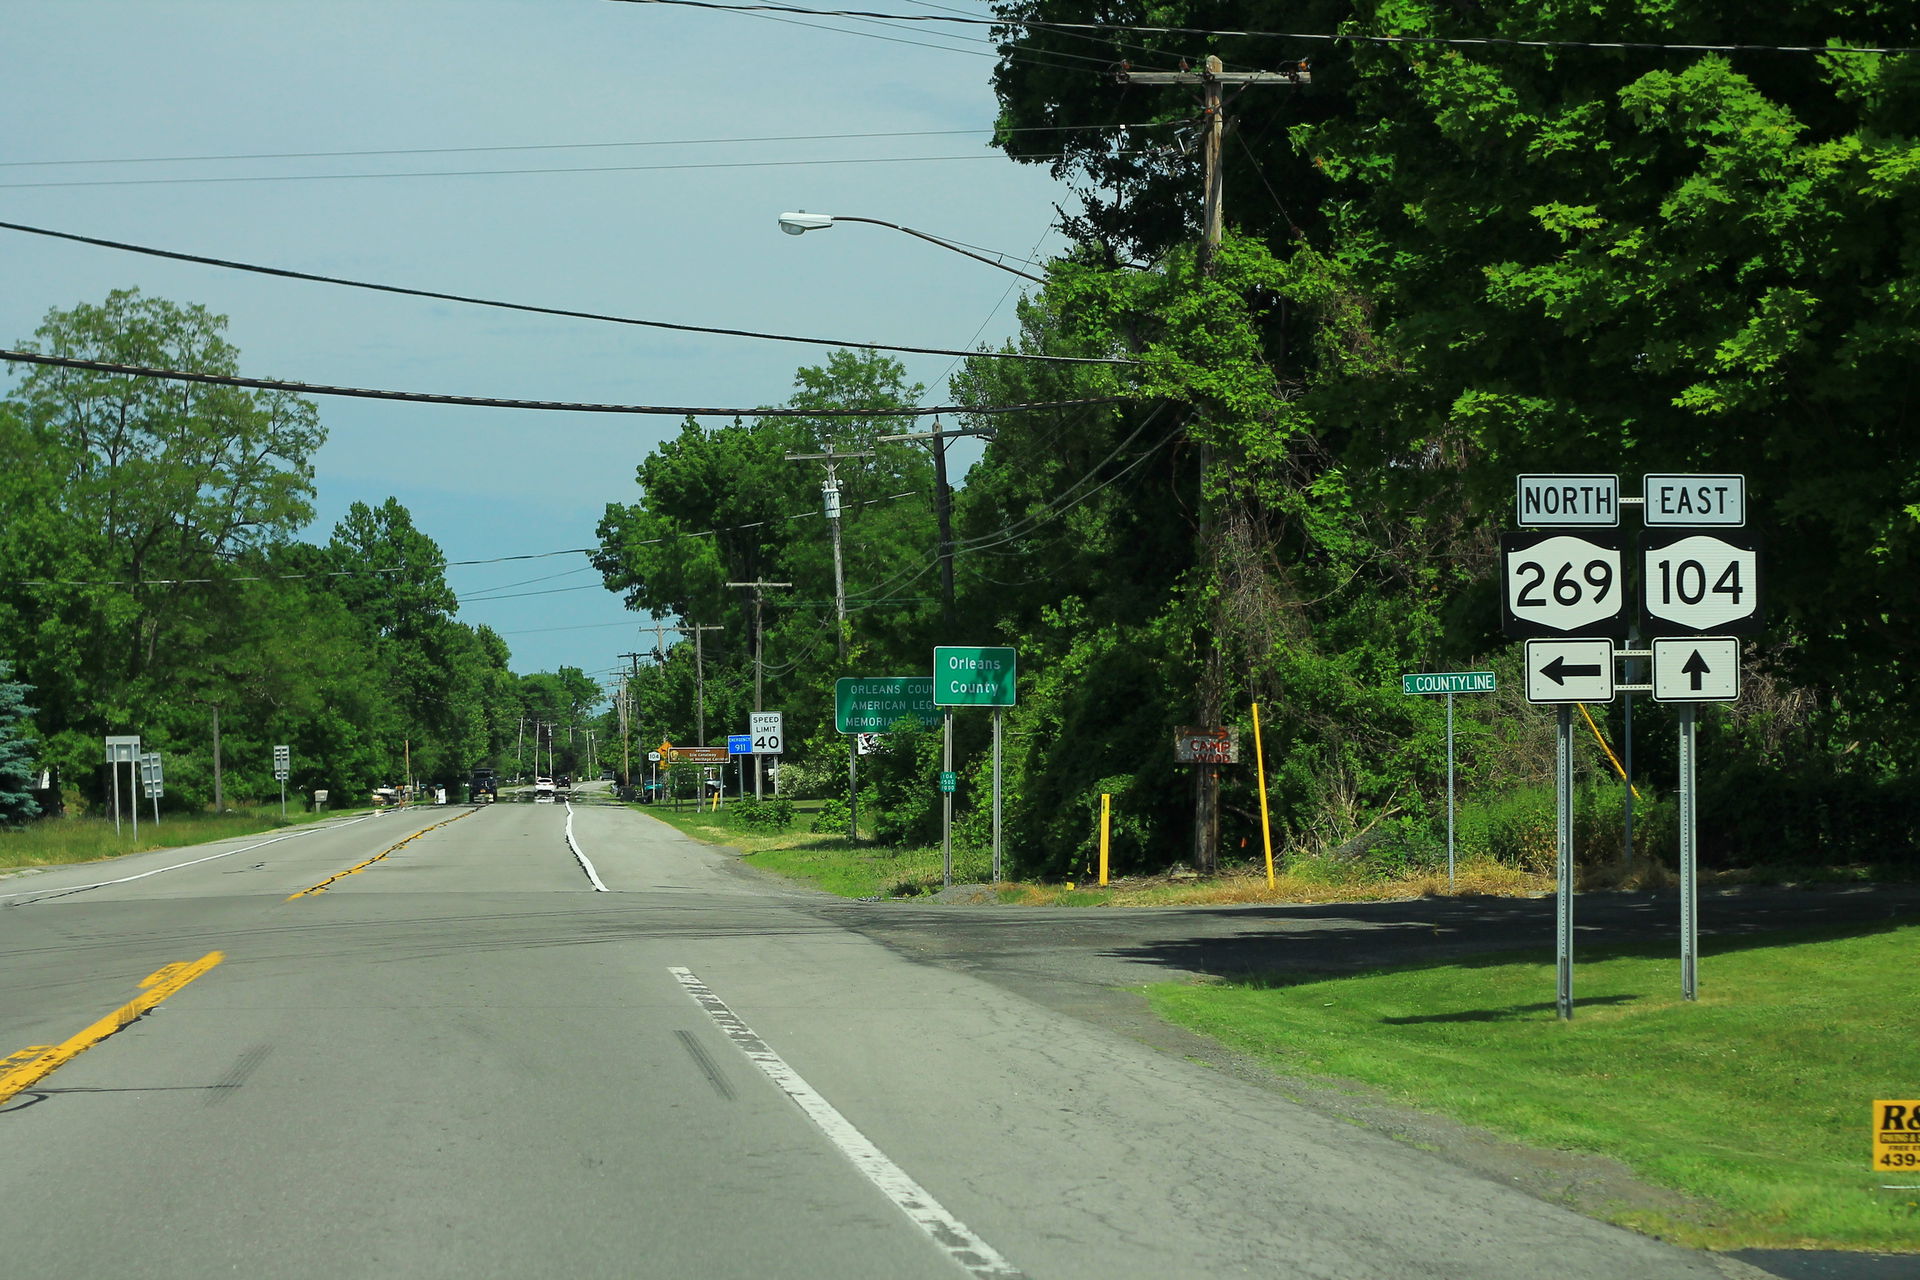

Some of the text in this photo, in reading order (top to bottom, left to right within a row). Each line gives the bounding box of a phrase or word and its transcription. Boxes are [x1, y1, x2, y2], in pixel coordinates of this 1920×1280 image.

[1525, 486, 1612, 514] NORTH
[1660, 486, 1729, 514] EAST
[1516, 559, 1613, 607] 269
[1658, 559, 1743, 605] 104
[949, 656, 1001, 670] Orleans
[850, 684, 901, 695] ORLEANS
[950, 680, 999, 696] County
[1405, 674, 1494, 692] S. COUNTYLINE
[851, 700, 906, 710] AMERICAN
[754, 736, 779, 749] 40
[1190, 739, 1231, 752] CAMP
